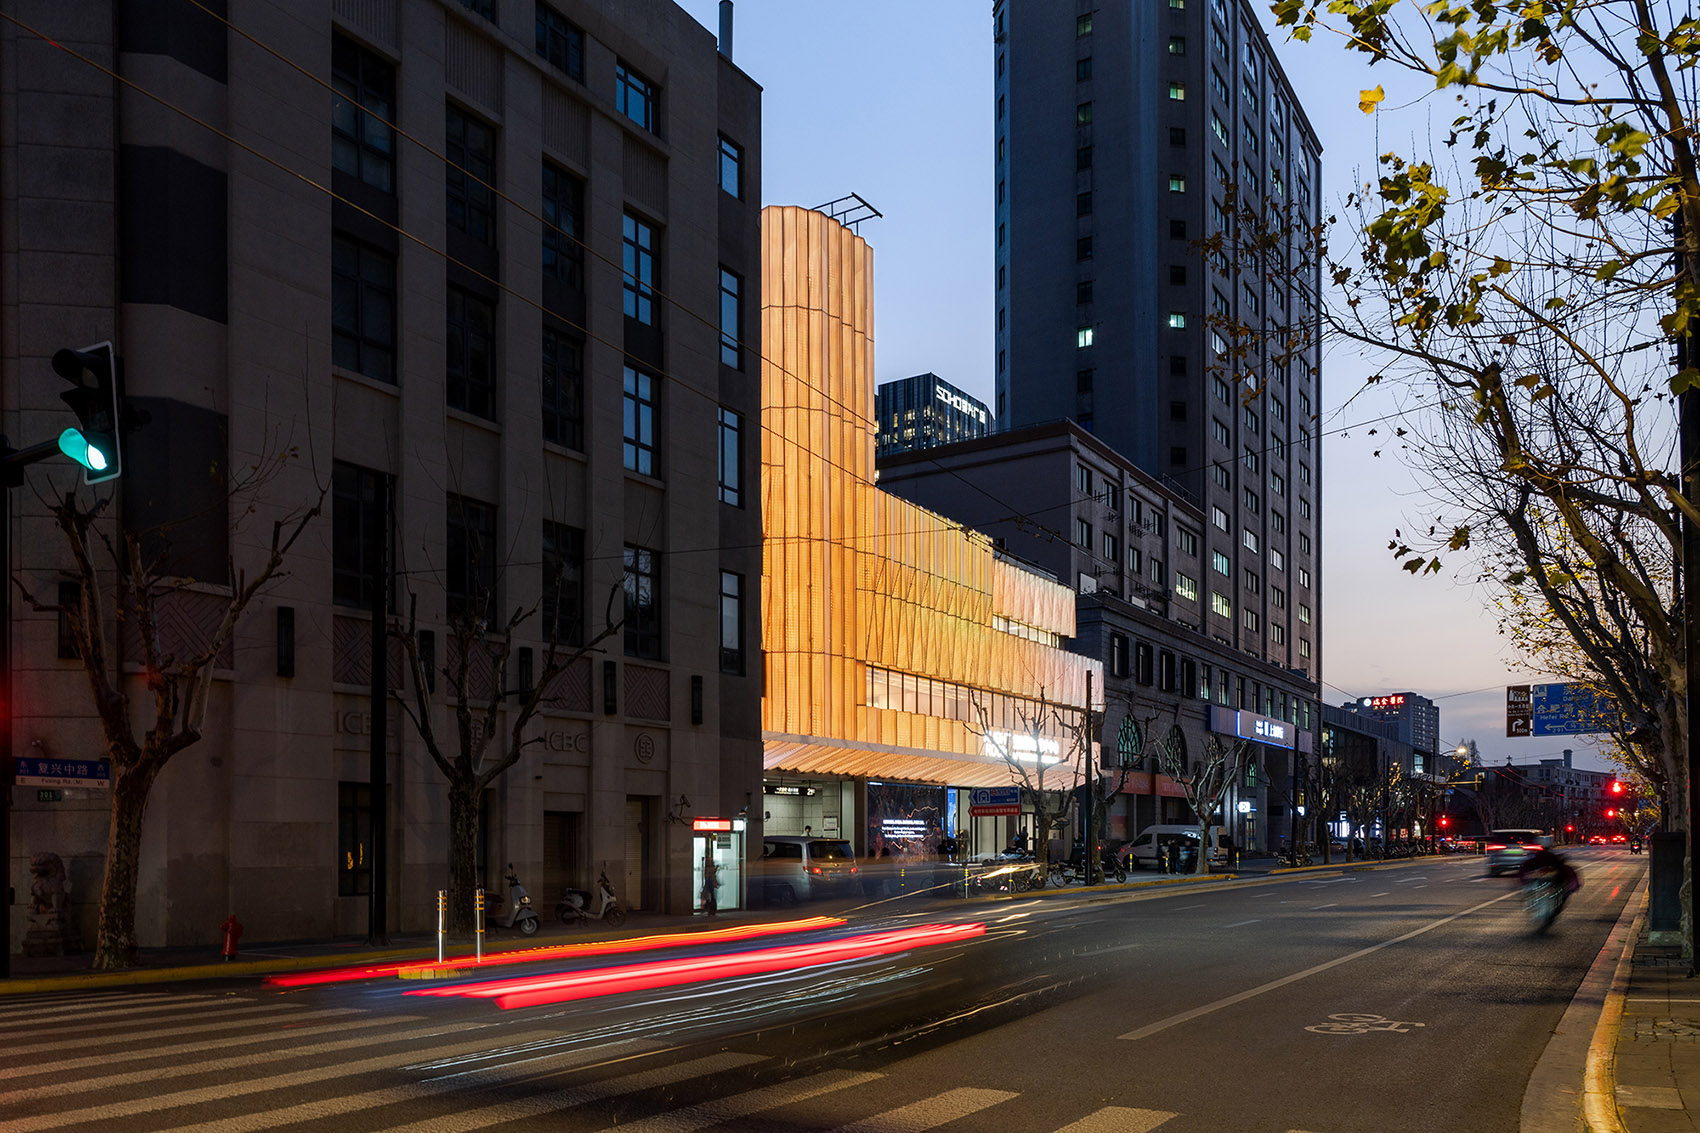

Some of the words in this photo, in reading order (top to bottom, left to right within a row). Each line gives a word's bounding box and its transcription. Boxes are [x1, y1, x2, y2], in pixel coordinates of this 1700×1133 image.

[1540, 713, 1558, 721] Hefei
[545, 731, 587, 753] ICBC
[38, 762, 88, 776] 复兴中路
